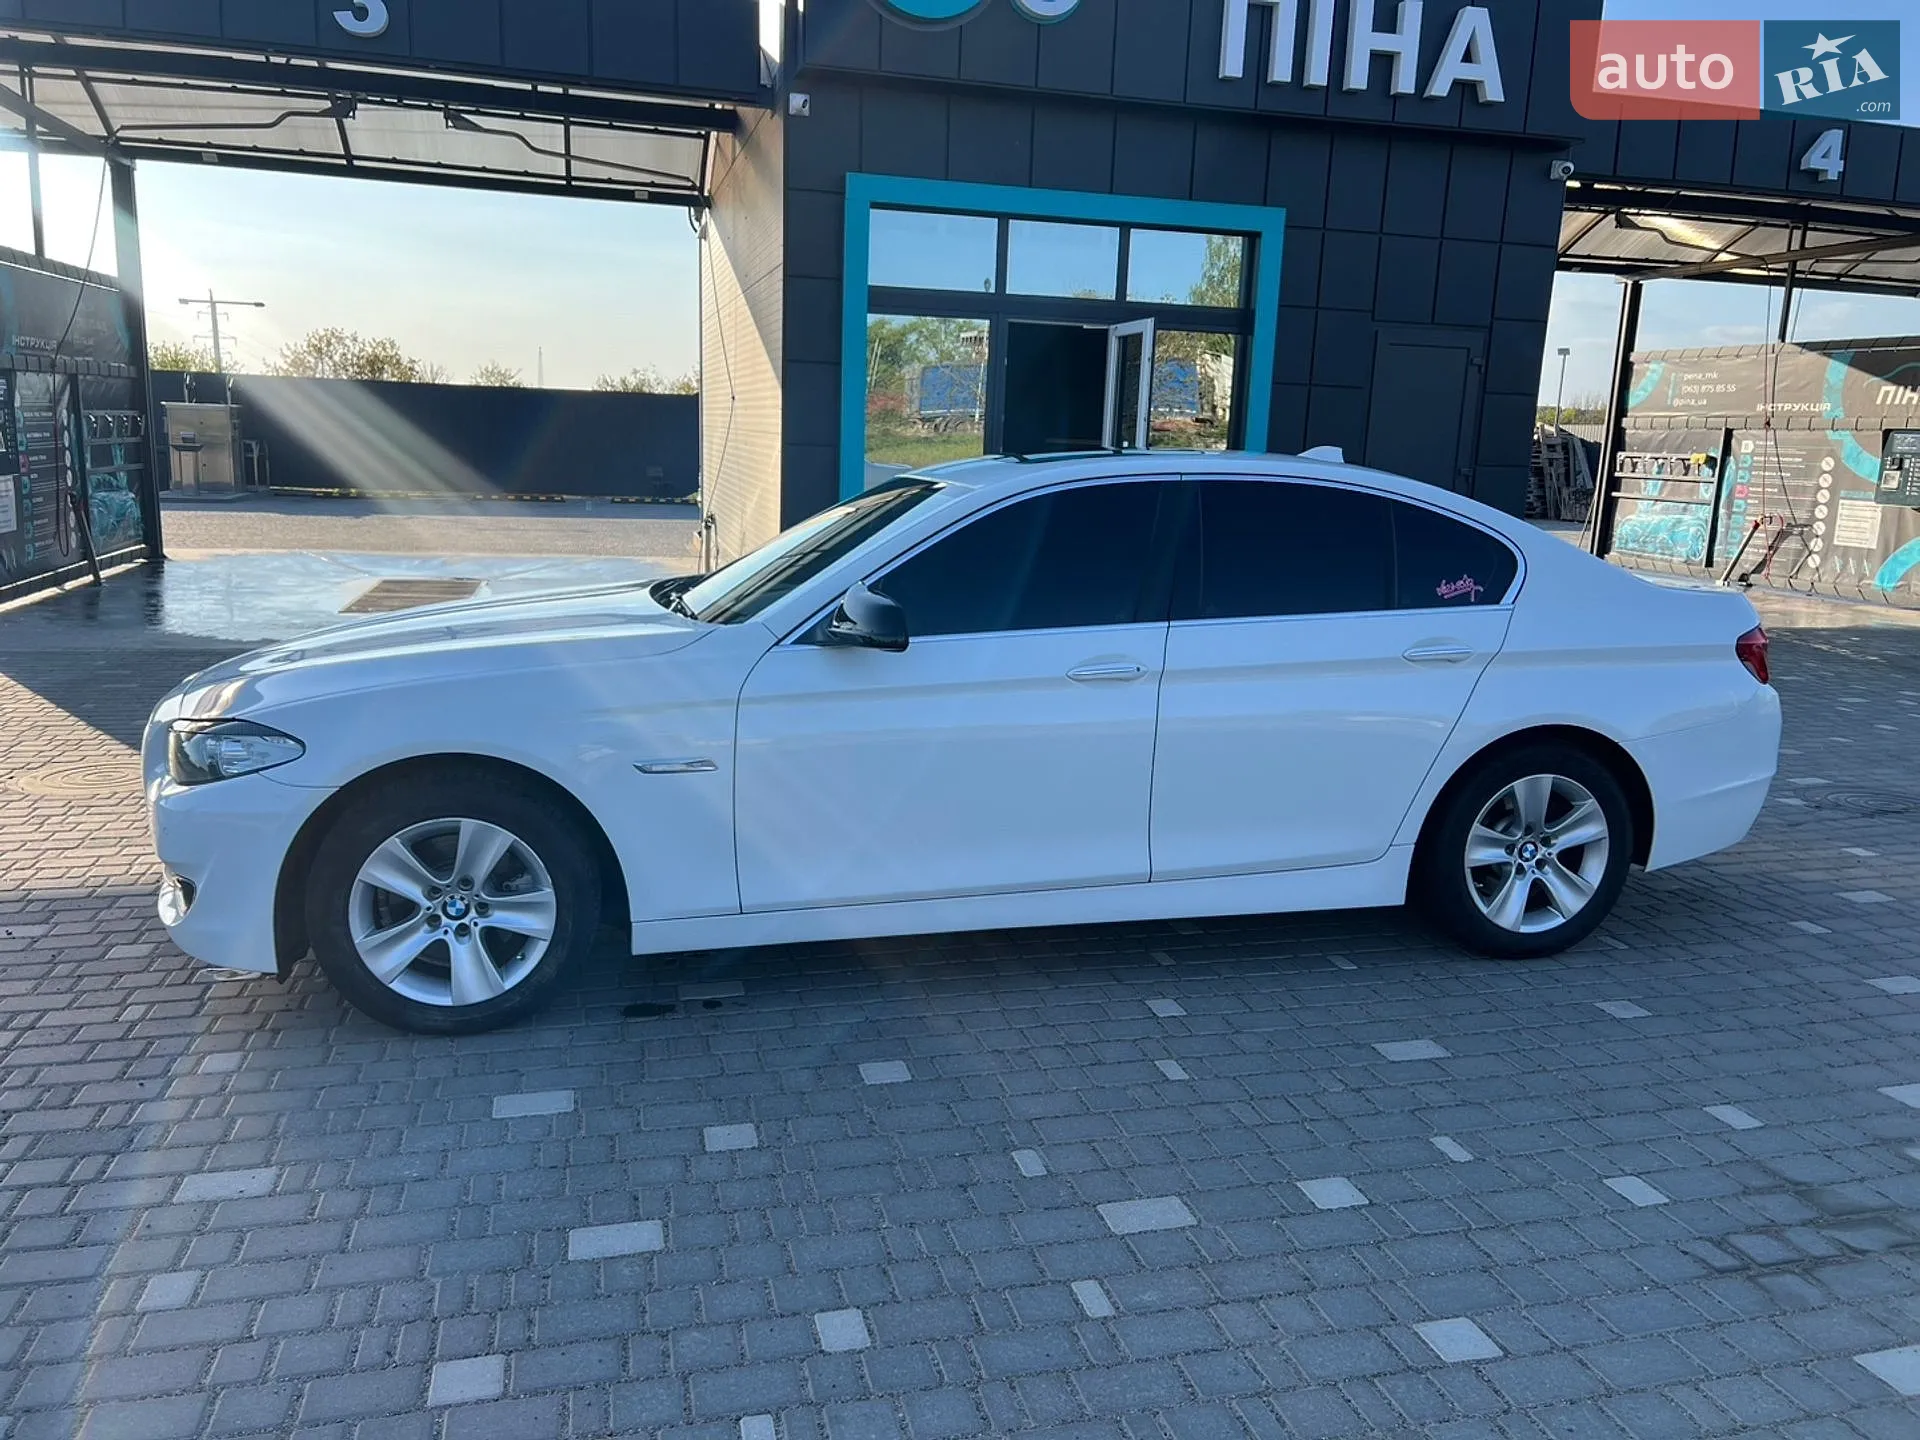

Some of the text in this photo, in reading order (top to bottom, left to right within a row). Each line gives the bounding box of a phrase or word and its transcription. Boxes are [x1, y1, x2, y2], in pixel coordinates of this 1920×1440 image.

[1218, 0, 1506, 104] ПІНА
[1800, 127, 1845, 182] 4
[1756, 402, 1832, 412] ІНСТРУКЦІЯ
